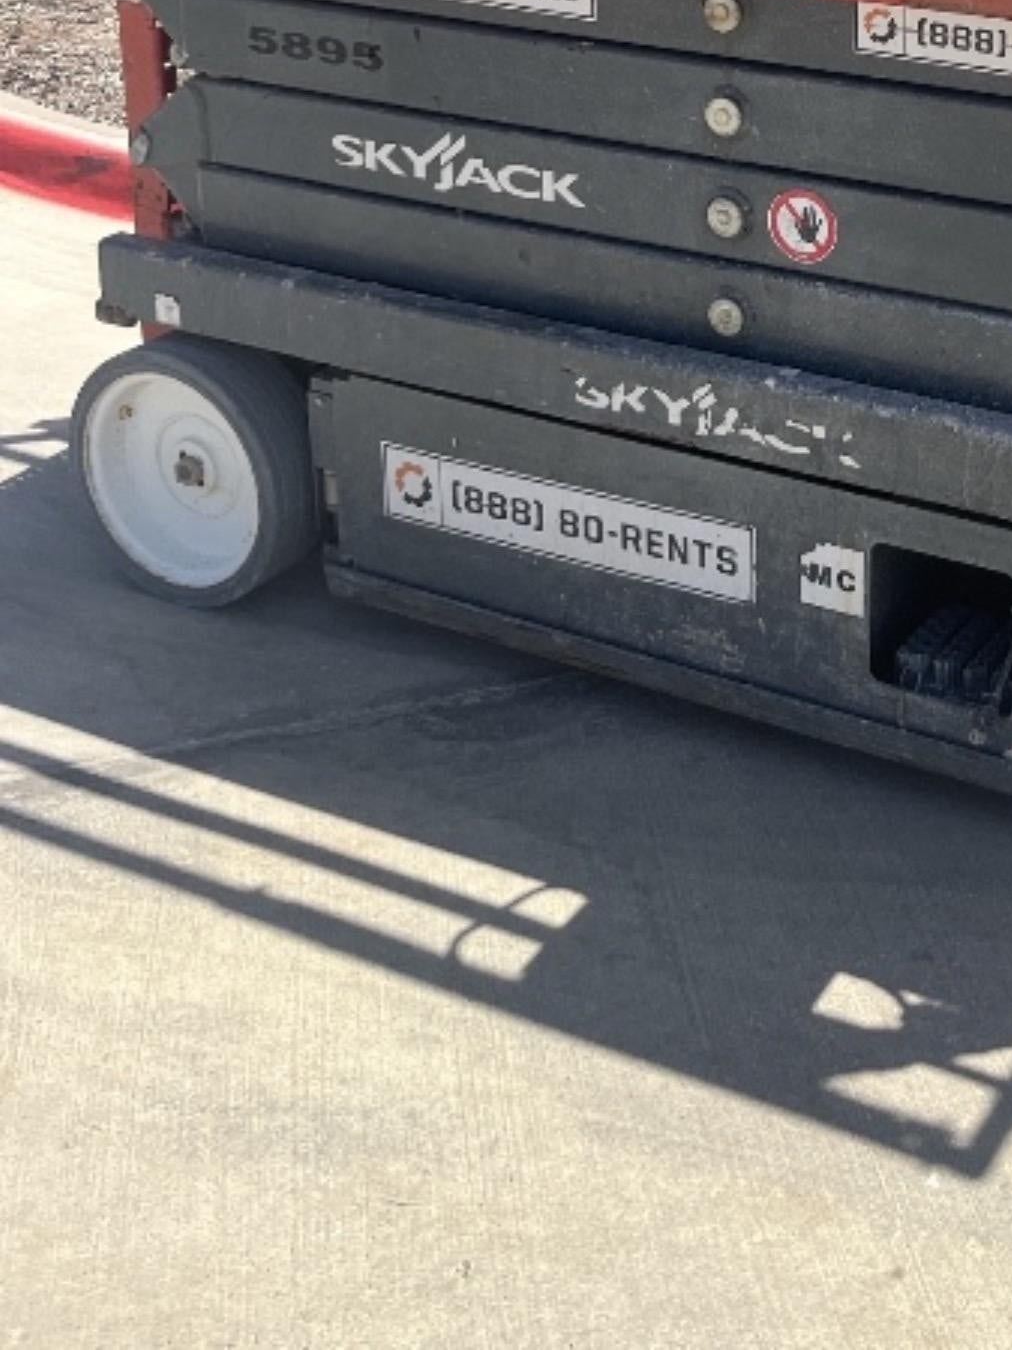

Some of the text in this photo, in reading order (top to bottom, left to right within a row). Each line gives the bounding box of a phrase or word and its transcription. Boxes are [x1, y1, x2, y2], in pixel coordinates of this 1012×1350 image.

[247, 25, 384, 72] 5895
[917, 17, 1006, 57] (888)
[331, 130, 585, 208] SKYJACK
[451, 479, 739, 577] (888) 80-RENTS
